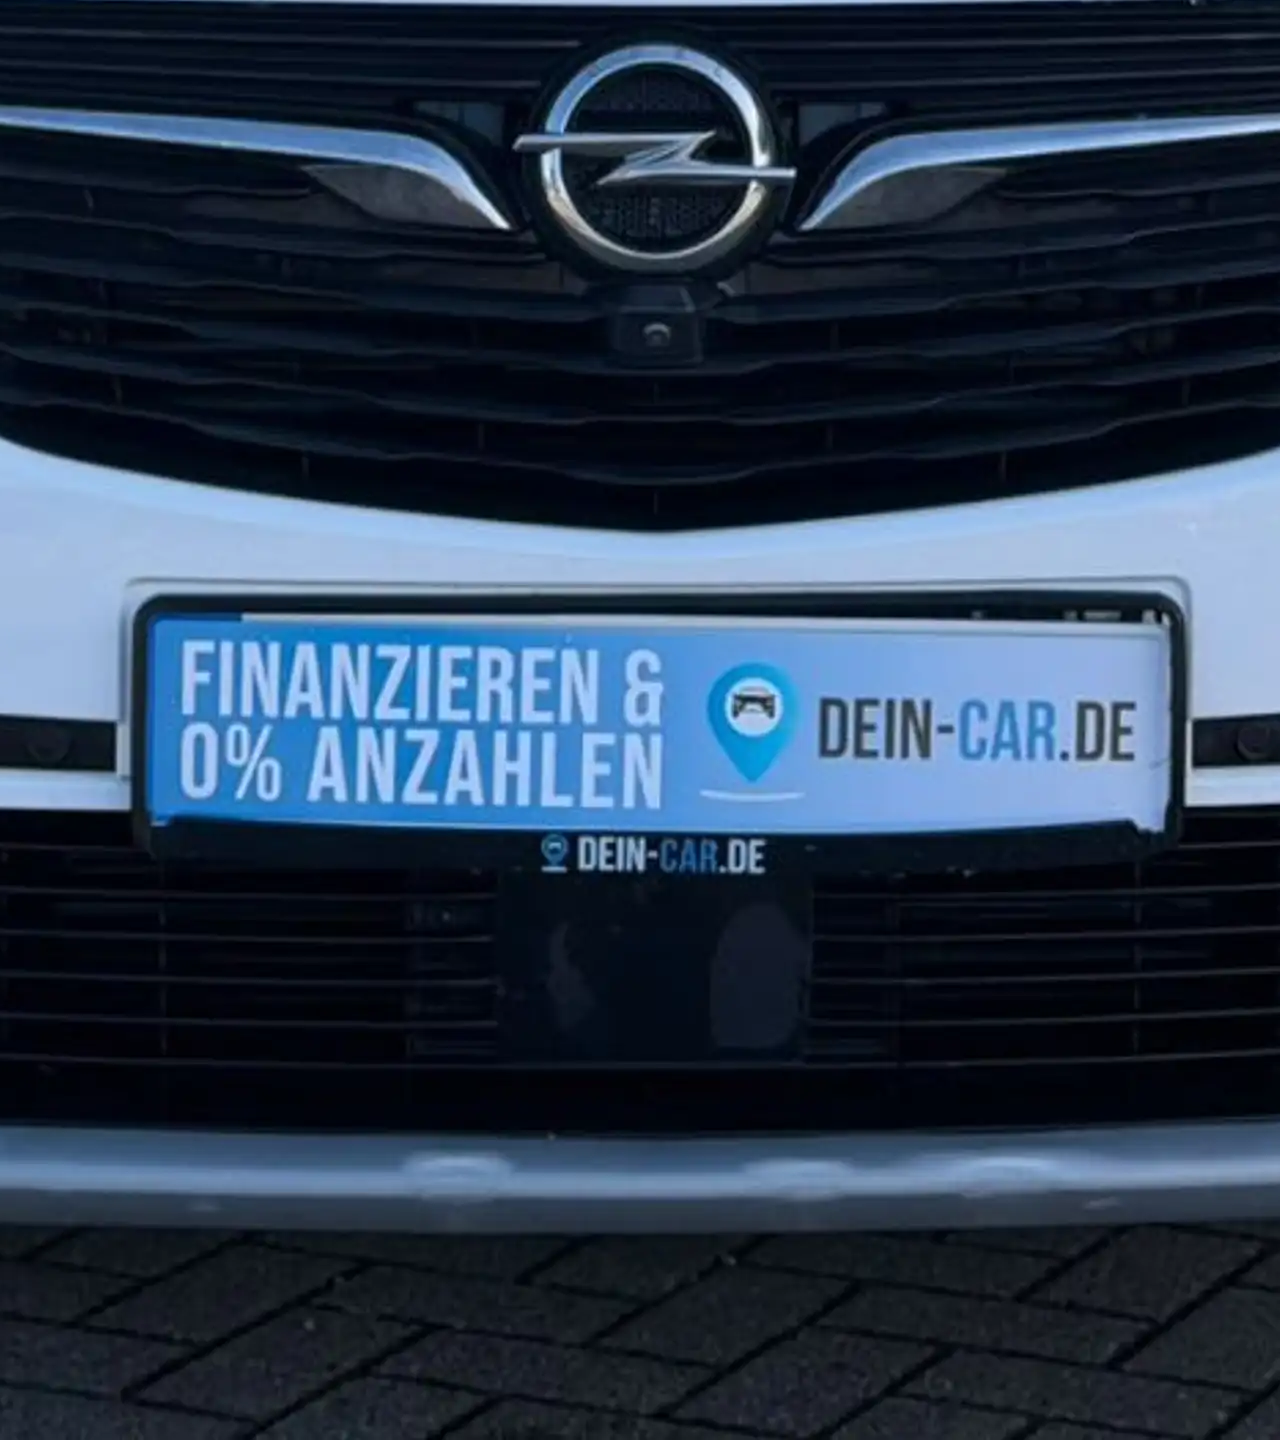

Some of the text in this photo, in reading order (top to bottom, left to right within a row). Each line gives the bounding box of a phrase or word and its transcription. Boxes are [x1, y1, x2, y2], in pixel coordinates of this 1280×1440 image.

[180, 640, 664, 728] FINANZIEREN &
[180, 722, 664, 810] 0% ANZAHLEN
[821, 697, 1138, 761] DEIN-CAR.DE
[577, 835, 766, 875] DEIN-CAR.DE
